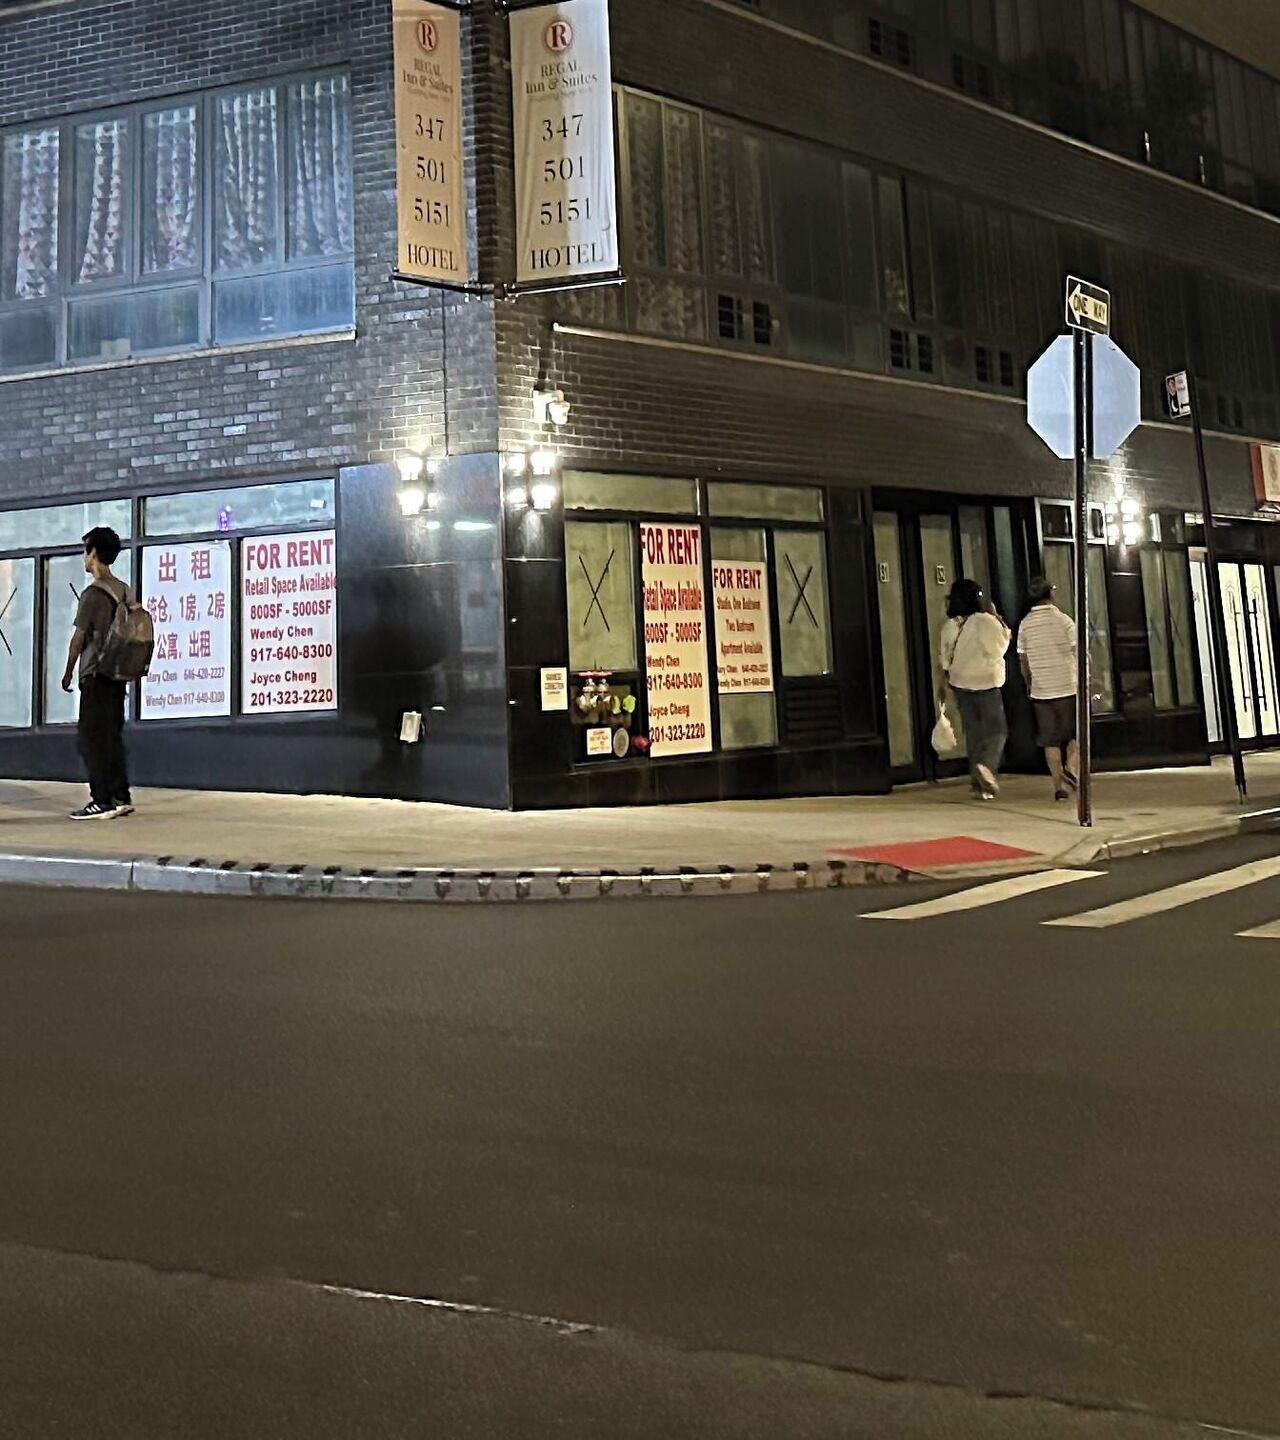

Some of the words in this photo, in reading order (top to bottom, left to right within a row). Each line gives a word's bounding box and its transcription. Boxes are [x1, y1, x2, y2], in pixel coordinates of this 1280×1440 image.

[403, 69, 417, 84] Inn
[541, 59, 580, 77] REGAL
[526, 81, 545, 94] Inn
[548, 79, 557, 90] &
[562, 73, 598, 88] Suites
[415, 114, 444, 141] 347
[542, 114, 583, 142] 347
[417, 156, 445, 184] 501
[544, 156, 583, 183] 501
[415, 198, 449, 228] 5151
[540, 197, 591, 226] 5151
[408, 243, 458, 271] HOTEL
[531, 242, 603, 270] HOTEL
[1073, 294, 1088, 315] ONE
[1093, 301, 1106, 321] WAY
[247, 543, 281, 571] FOR
[287, 538, 334, 568] RENT
[640, 527, 665, 565] FOR
[668, 528, 698, 565] RENT
[158, 549, 211, 583] 出租
[245, 577, 269, 596] Retail
[272, 575, 297, 598] Space
[713, 568, 733, 589] FOR
[737, 568, 761, 590] RENT
[251, 603, 282, 620] 800SF
[293, 600, 332, 617] 5000SF
[660, 580, 677, 619] Space
[678, 580, 702, 611] Available
[250, 627, 284, 641] Wendy
[287, 626, 313, 638] Chen
[645, 623, 668, 644] 800SF
[676, 622, 702, 643] 5000SF
[251, 644, 333, 662] 917-640-8300
[647, 655, 665, 670] Wendy
[666, 655, 680, 667] Chen
[250, 672, 281, 686] Joyce
[285, 670, 317, 684] Cheng
[648, 673, 703, 691] 917-640-8300
[146, 693, 166, 709] Wendy
[167, 693, 182, 706] Chen
[251, 689, 333, 706] 201-323-2220
[649, 705, 668, 720] Joyce
[670, 703, 690, 717] Cheng
[650, 723, 705, 743] 201-323-2220
